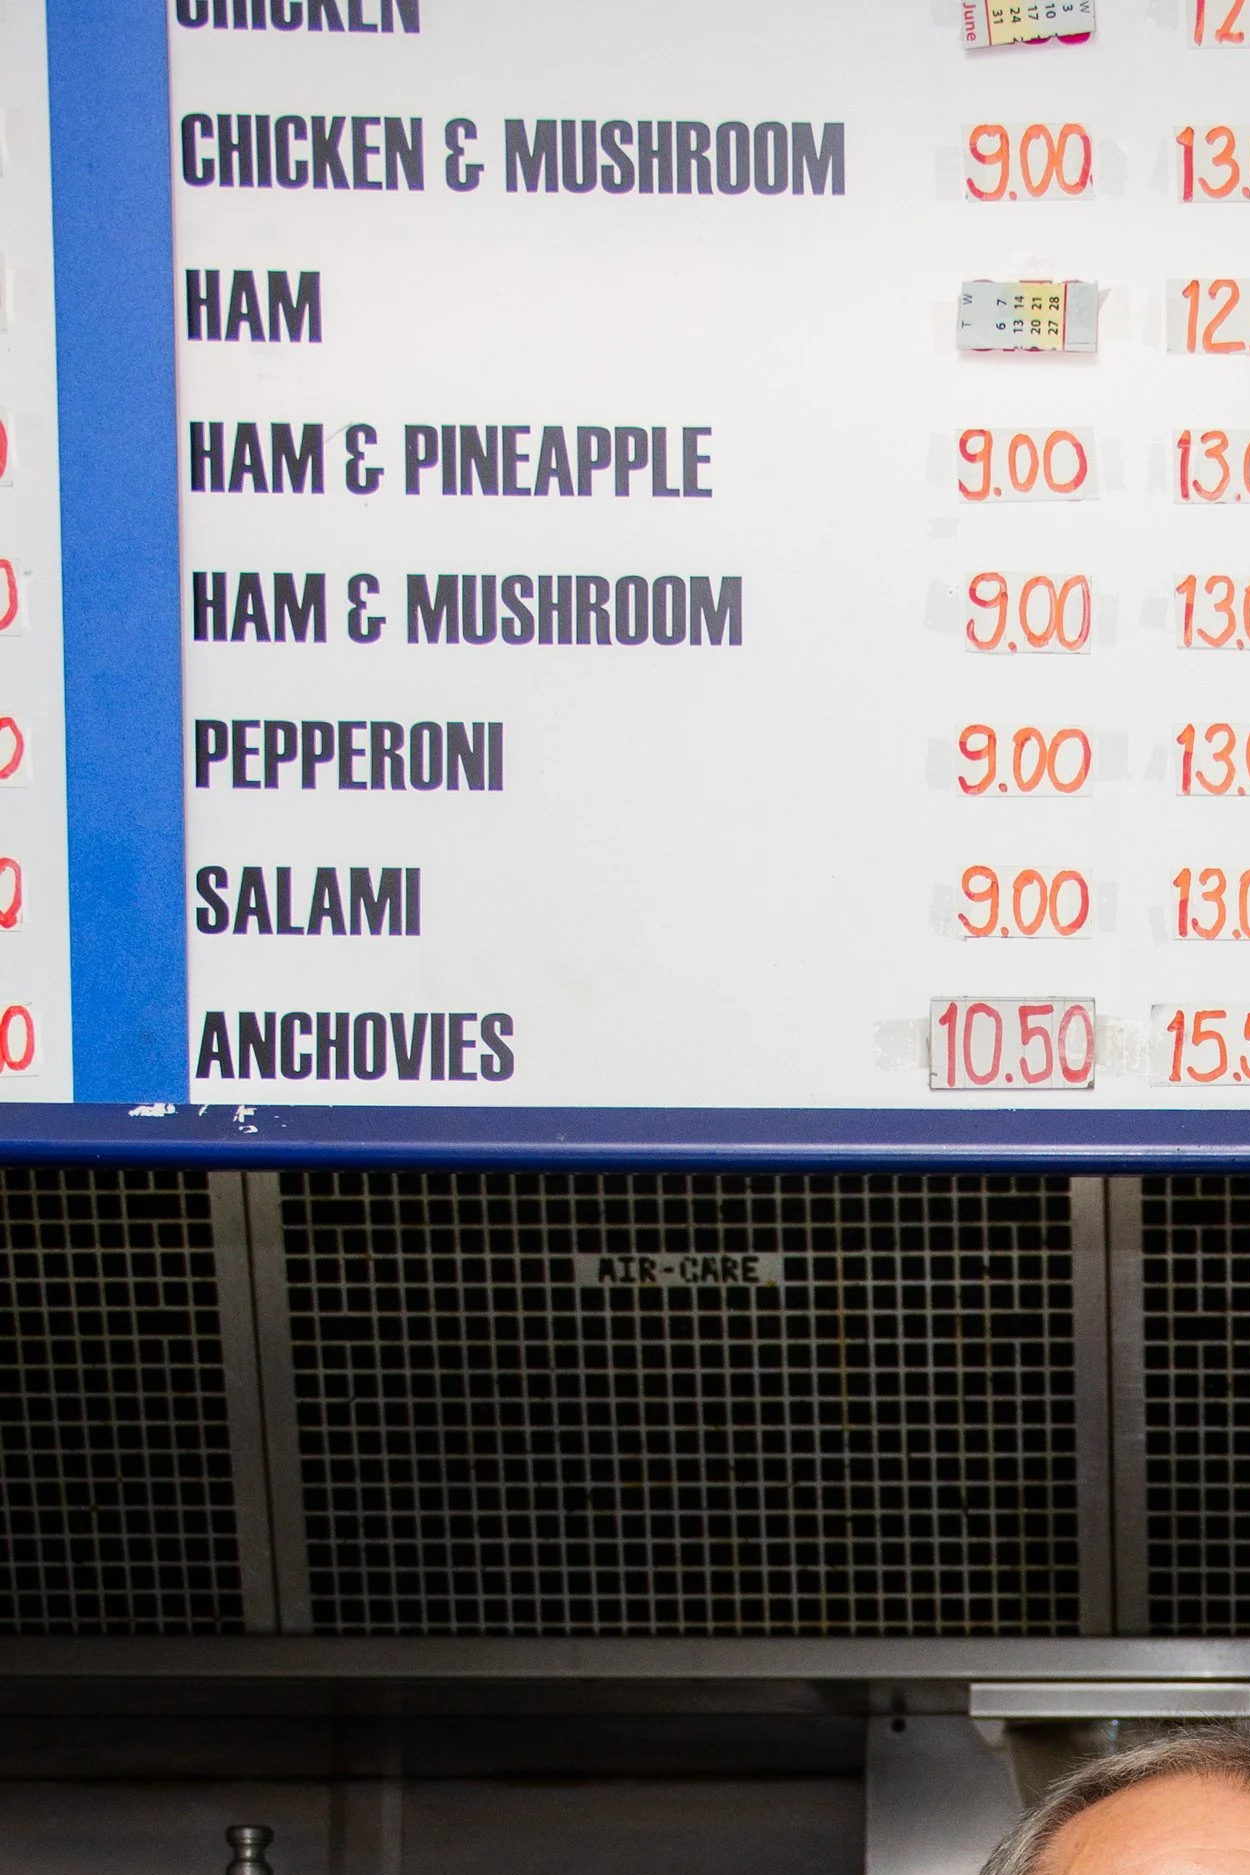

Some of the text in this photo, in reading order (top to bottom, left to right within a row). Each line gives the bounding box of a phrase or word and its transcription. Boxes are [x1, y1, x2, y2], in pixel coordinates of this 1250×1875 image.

[963, 1, 977, 42] June
[993, 10, 1004, 24] 31
[1010, 8, 1021, 23] 24
[1028, 6, 1039, 20] 17
[1045, 3, 1056, 18] 10
[181, 113, 845, 195] CHICKEN & MUSHROOM
[966, 124, 1093, 200] 9.00
[186, 269, 321, 343] HAM
[1013, 295, 1024, 333] 13 14
[1031, 297, 1042, 334] 20 21
[1048, 296, 1059, 335] 27 28
[190, 421, 712, 498] HAM & PINEAPPLE
[959, 429, 1087, 499] 9.00
[192, 571, 742, 646] HAM & MUSHROOM
[966, 573, 1090, 652] 9.00
[195, 719, 503, 791] PEPPERONI
[958, 725, 1091, 794] 9.00
[196, 866, 420, 936] SALAMI
[958, 866, 1089, 937] 9.00
[196, 1011, 514, 1082] ANCHOVIES
[940, 1003, 1096, 1087] 10.50
[598, 1255, 760, 1284] AIR-CARE
